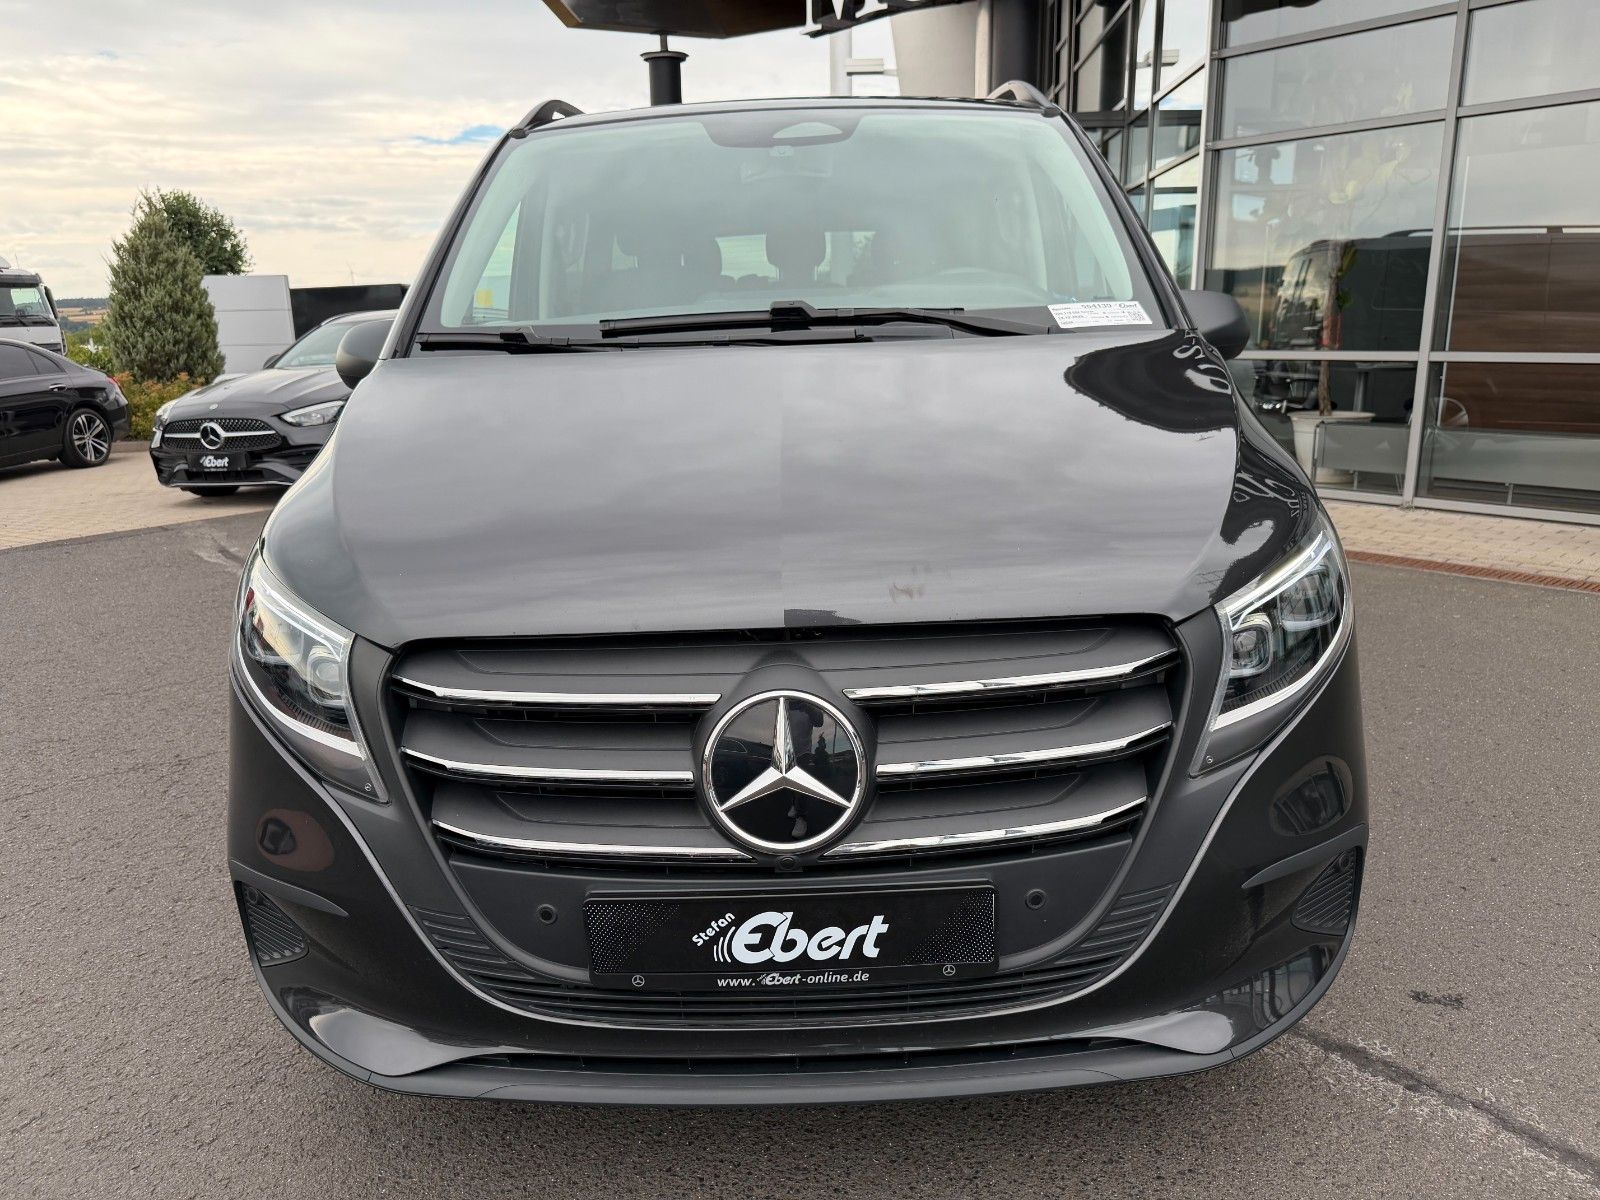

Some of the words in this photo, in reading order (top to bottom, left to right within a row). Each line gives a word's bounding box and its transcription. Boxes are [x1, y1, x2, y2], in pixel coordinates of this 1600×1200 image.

[205, 455, 229, 467] Ebert
[692, 912, 736, 947] Stefan
[731, 911, 890, 964] Ebert
